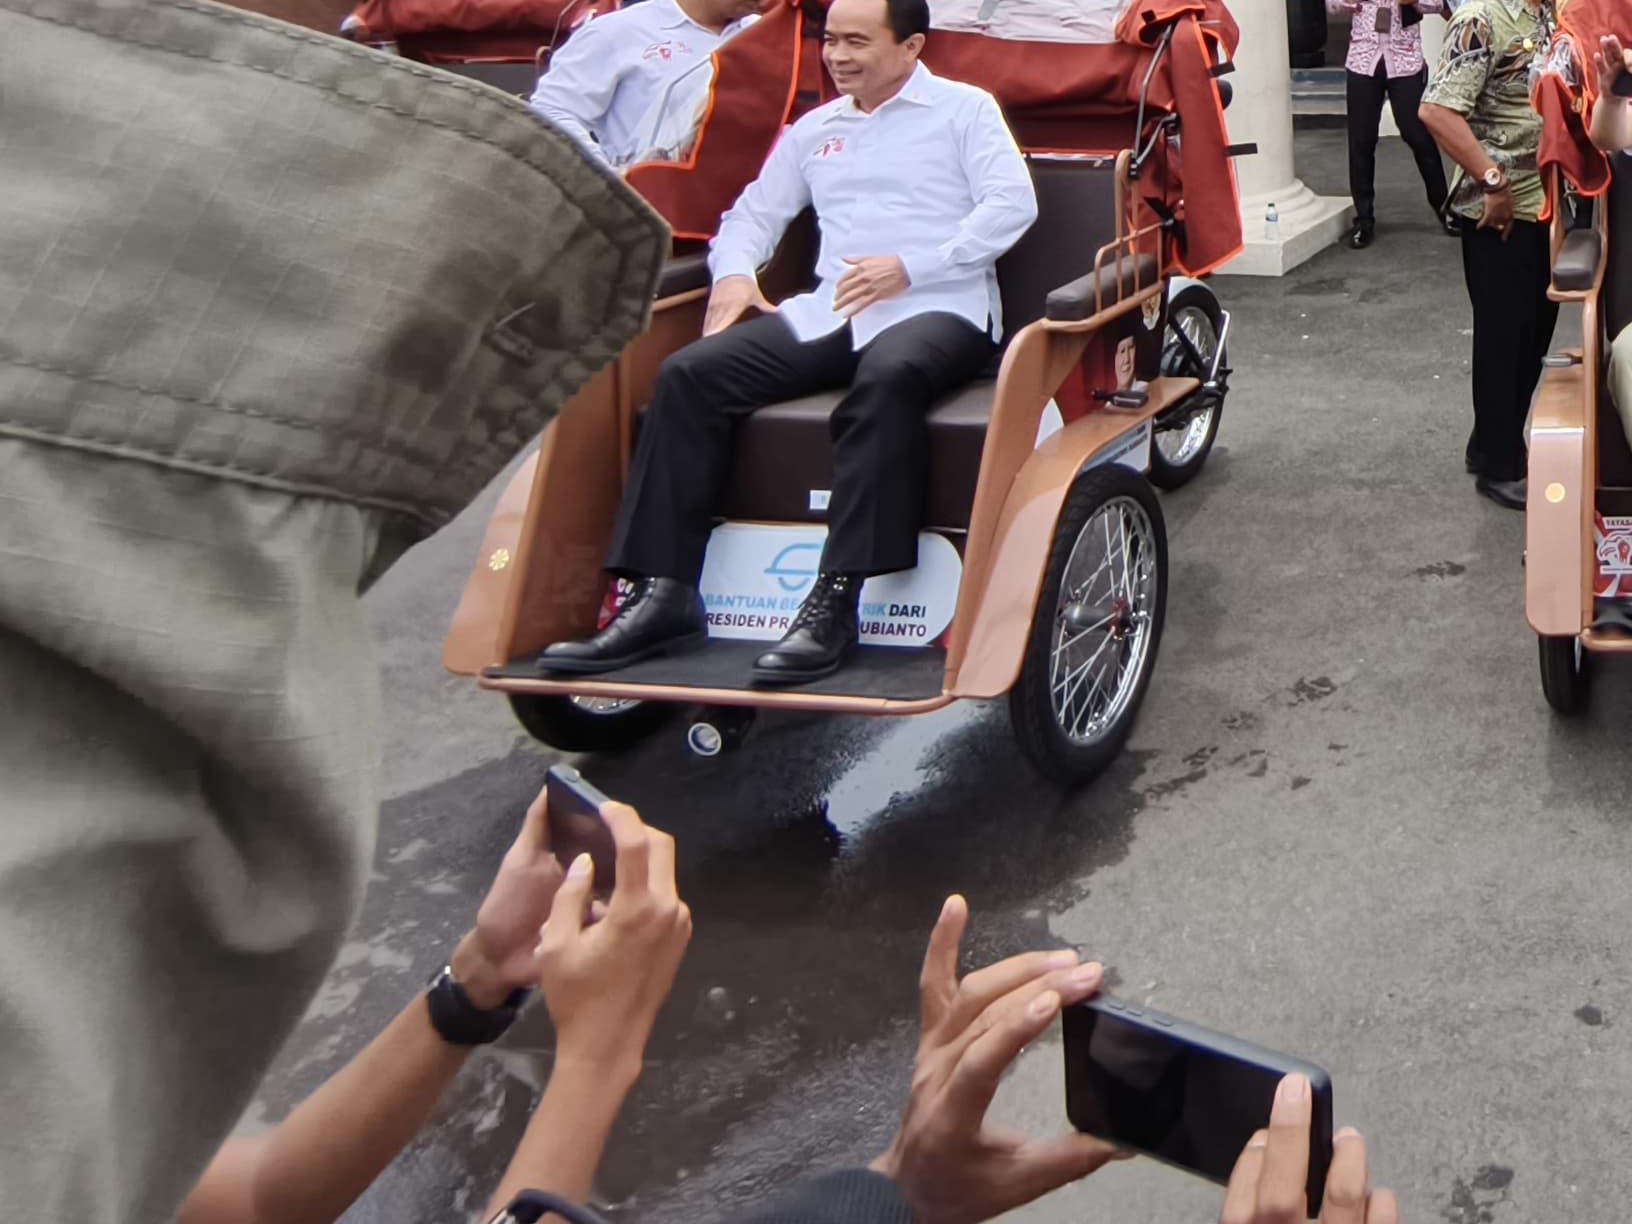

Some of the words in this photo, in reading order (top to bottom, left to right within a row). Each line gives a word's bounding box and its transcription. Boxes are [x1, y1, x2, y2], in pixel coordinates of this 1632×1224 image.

[889, 604, 926, 618] DARI
[705, 612, 766, 628] RESIDEN
[859, 621, 927, 637] UBIANTO
